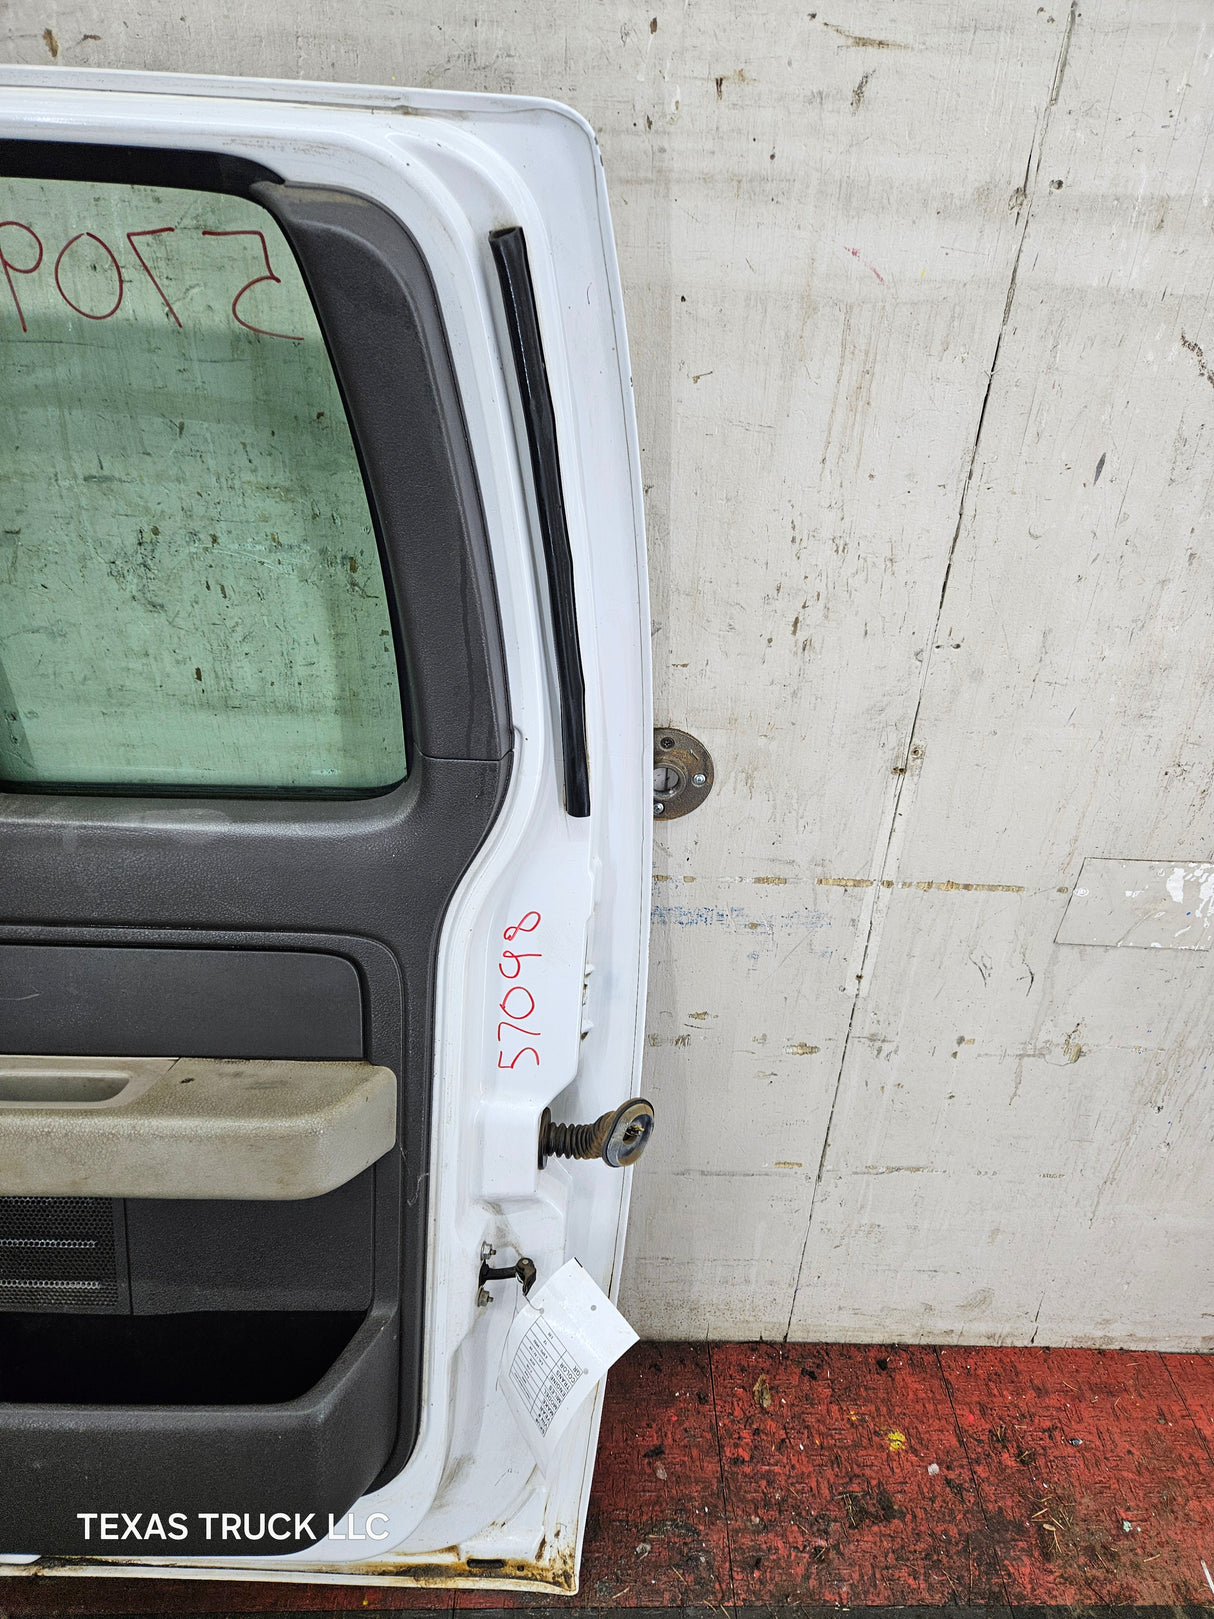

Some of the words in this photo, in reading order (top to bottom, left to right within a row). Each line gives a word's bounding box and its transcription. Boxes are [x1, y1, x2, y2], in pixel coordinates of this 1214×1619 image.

[498, 911, 542, 1069] 57098
[555, 1369, 570, 1390] TRANS
[559, 1361, 575, 1383] COLOR
[549, 1374, 565, 1396] ENGINE
